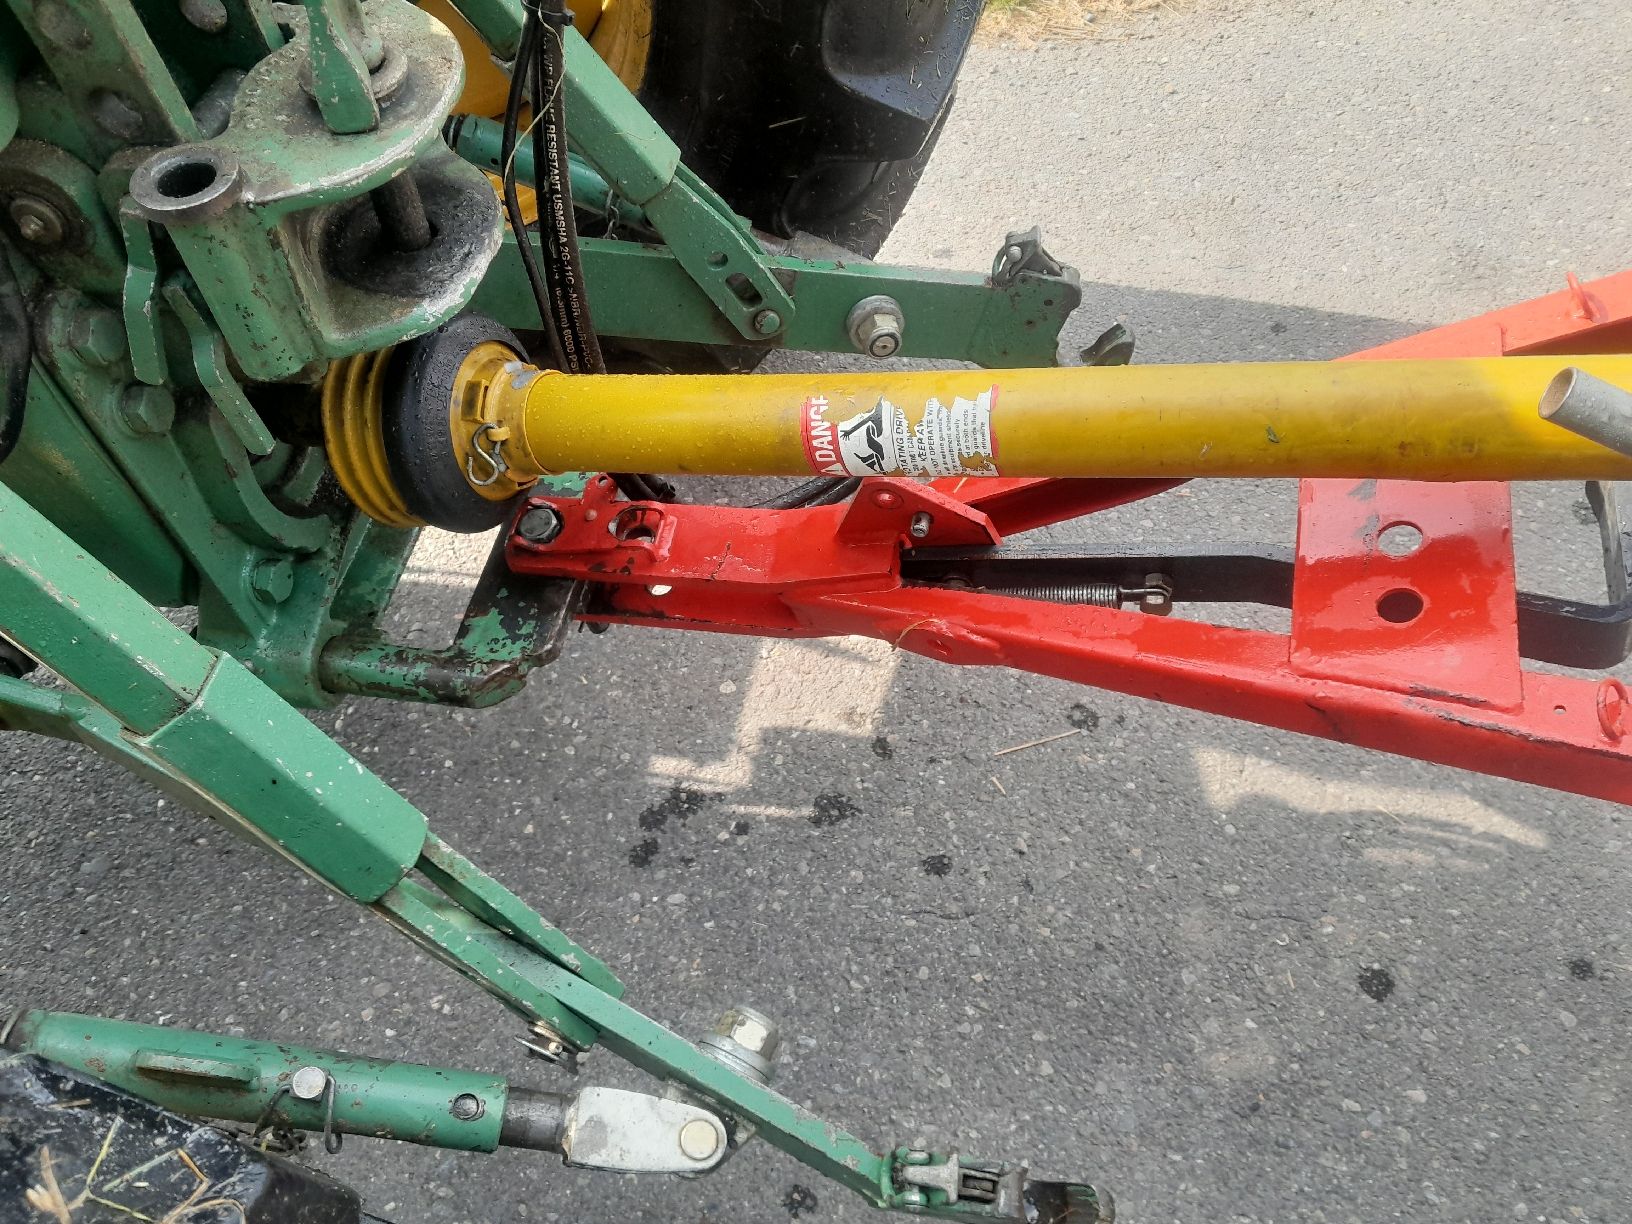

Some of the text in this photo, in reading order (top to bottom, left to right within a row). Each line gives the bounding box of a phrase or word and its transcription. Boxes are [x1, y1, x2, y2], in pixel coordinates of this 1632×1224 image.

[546, 124, 561, 192] RESISTANT
[552, 194, 568, 244] USMSHA
[560, 246, 575, 285] 2G-11C
[562, 328, 574, 354] 6000
[568, 354, 580, 371] PSI
[916, 437, 927, 462] KEEP
[926, 418, 936, 456] OPERATE
